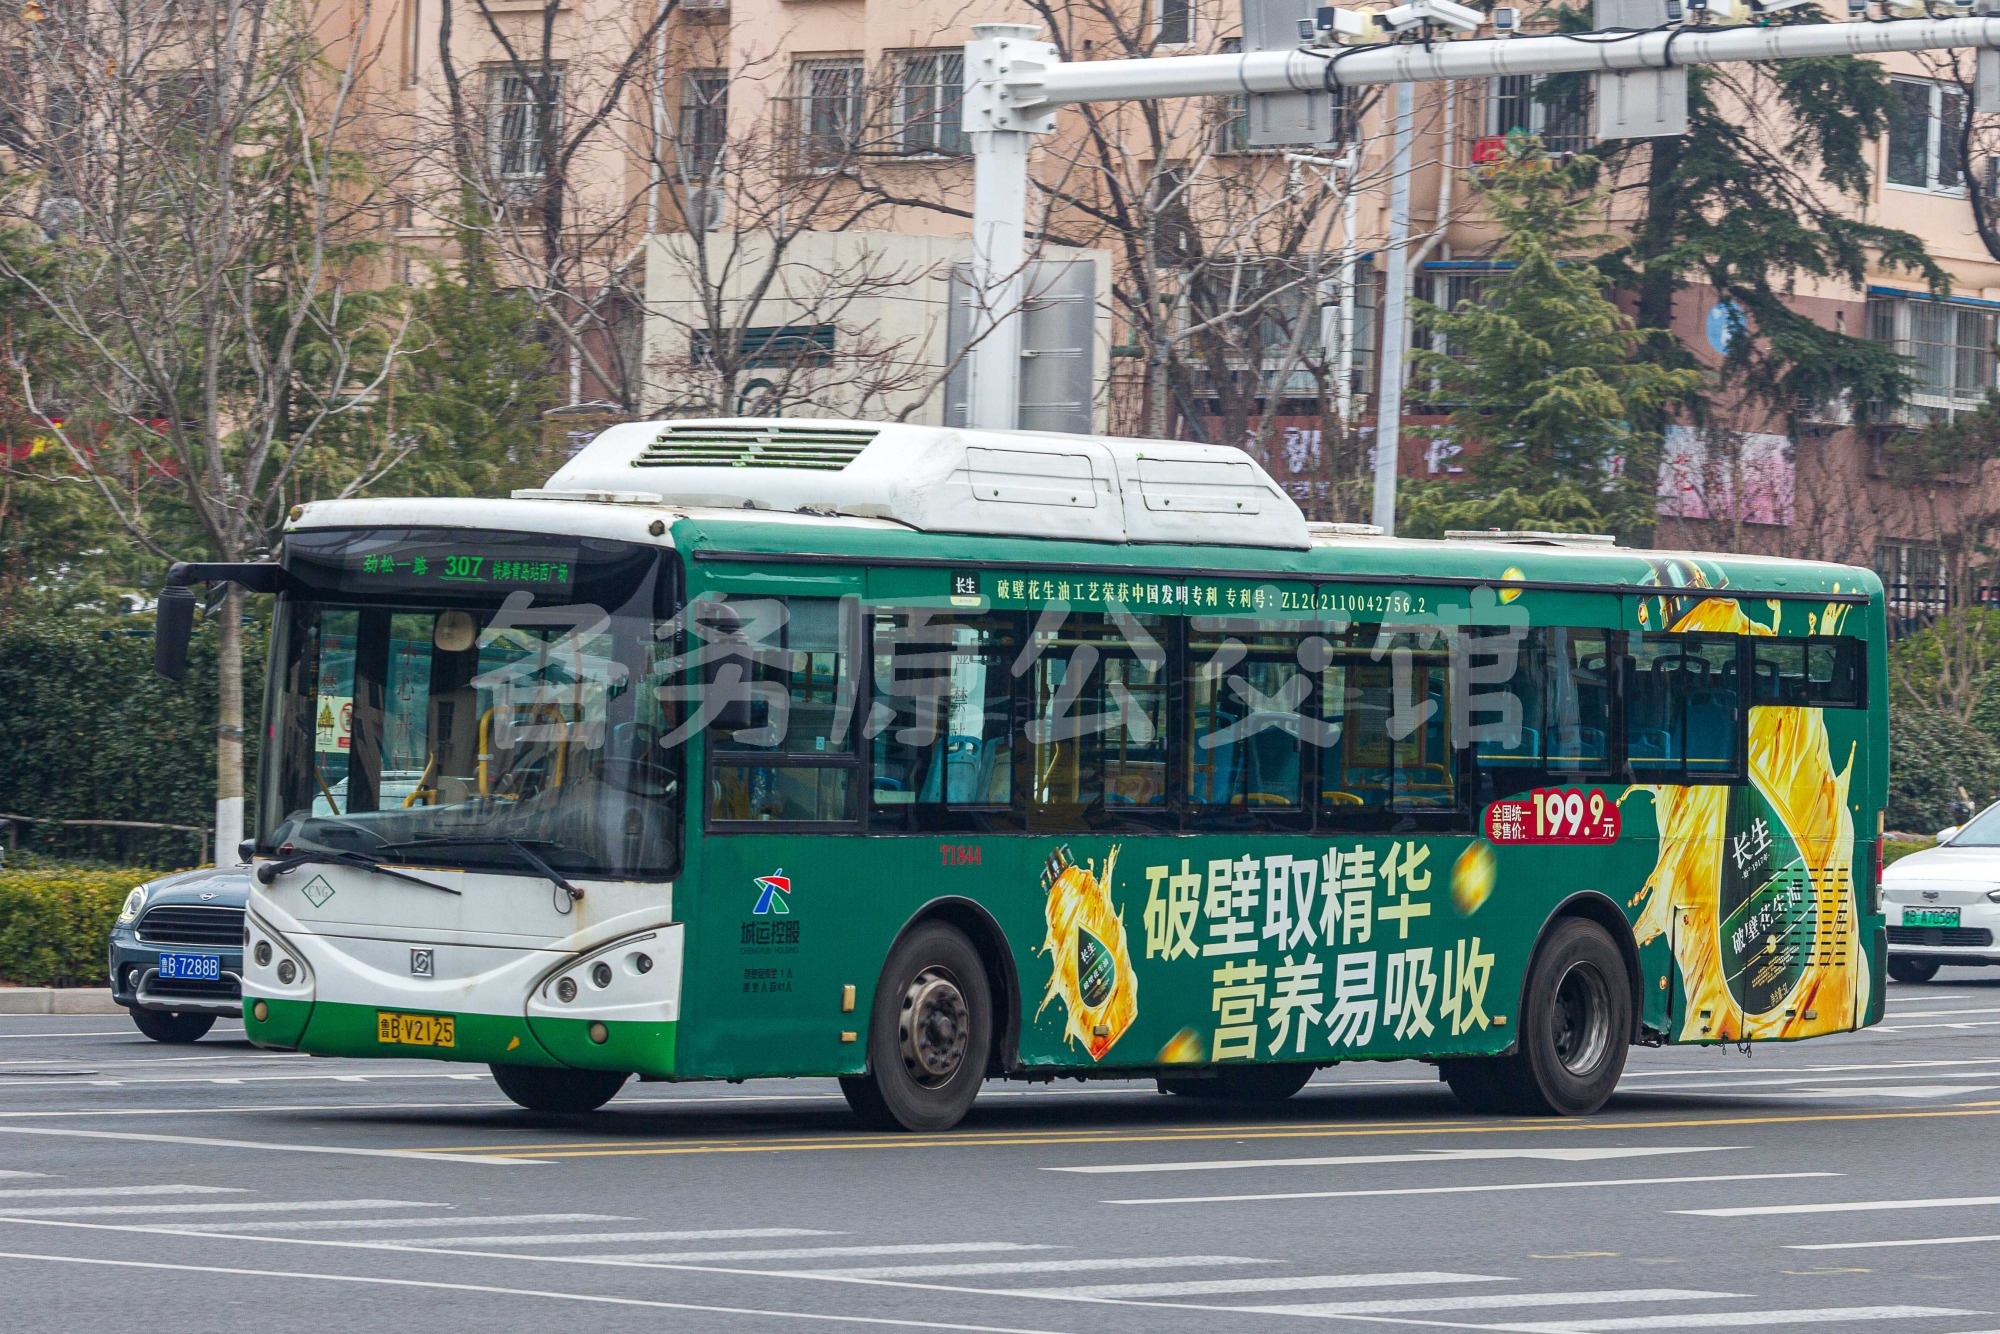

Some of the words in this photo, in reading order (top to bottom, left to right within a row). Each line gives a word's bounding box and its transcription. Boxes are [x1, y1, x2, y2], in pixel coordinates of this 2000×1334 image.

[363, 554, 428, 575] 劲松一路
[445, 555, 484, 576] 307
[955, 577, 976, 594] 长生
[997, 579, 1218, 606] 破壁花生油工艺荣获中国发明专利
[1492, 804, 1531, 822] 全国统一
[1732, 817, 1774, 870] 长生
[940, 845, 982, 865] T1844
[308, 885, 328, 898] CNG
[1143, 841, 1432, 962] 破壁取精华
[740, 921, 800, 945] 城运控股
[1080, 942, 1097, 963] 长生
[1211, 936, 1496, 1063] 营养易吸收
